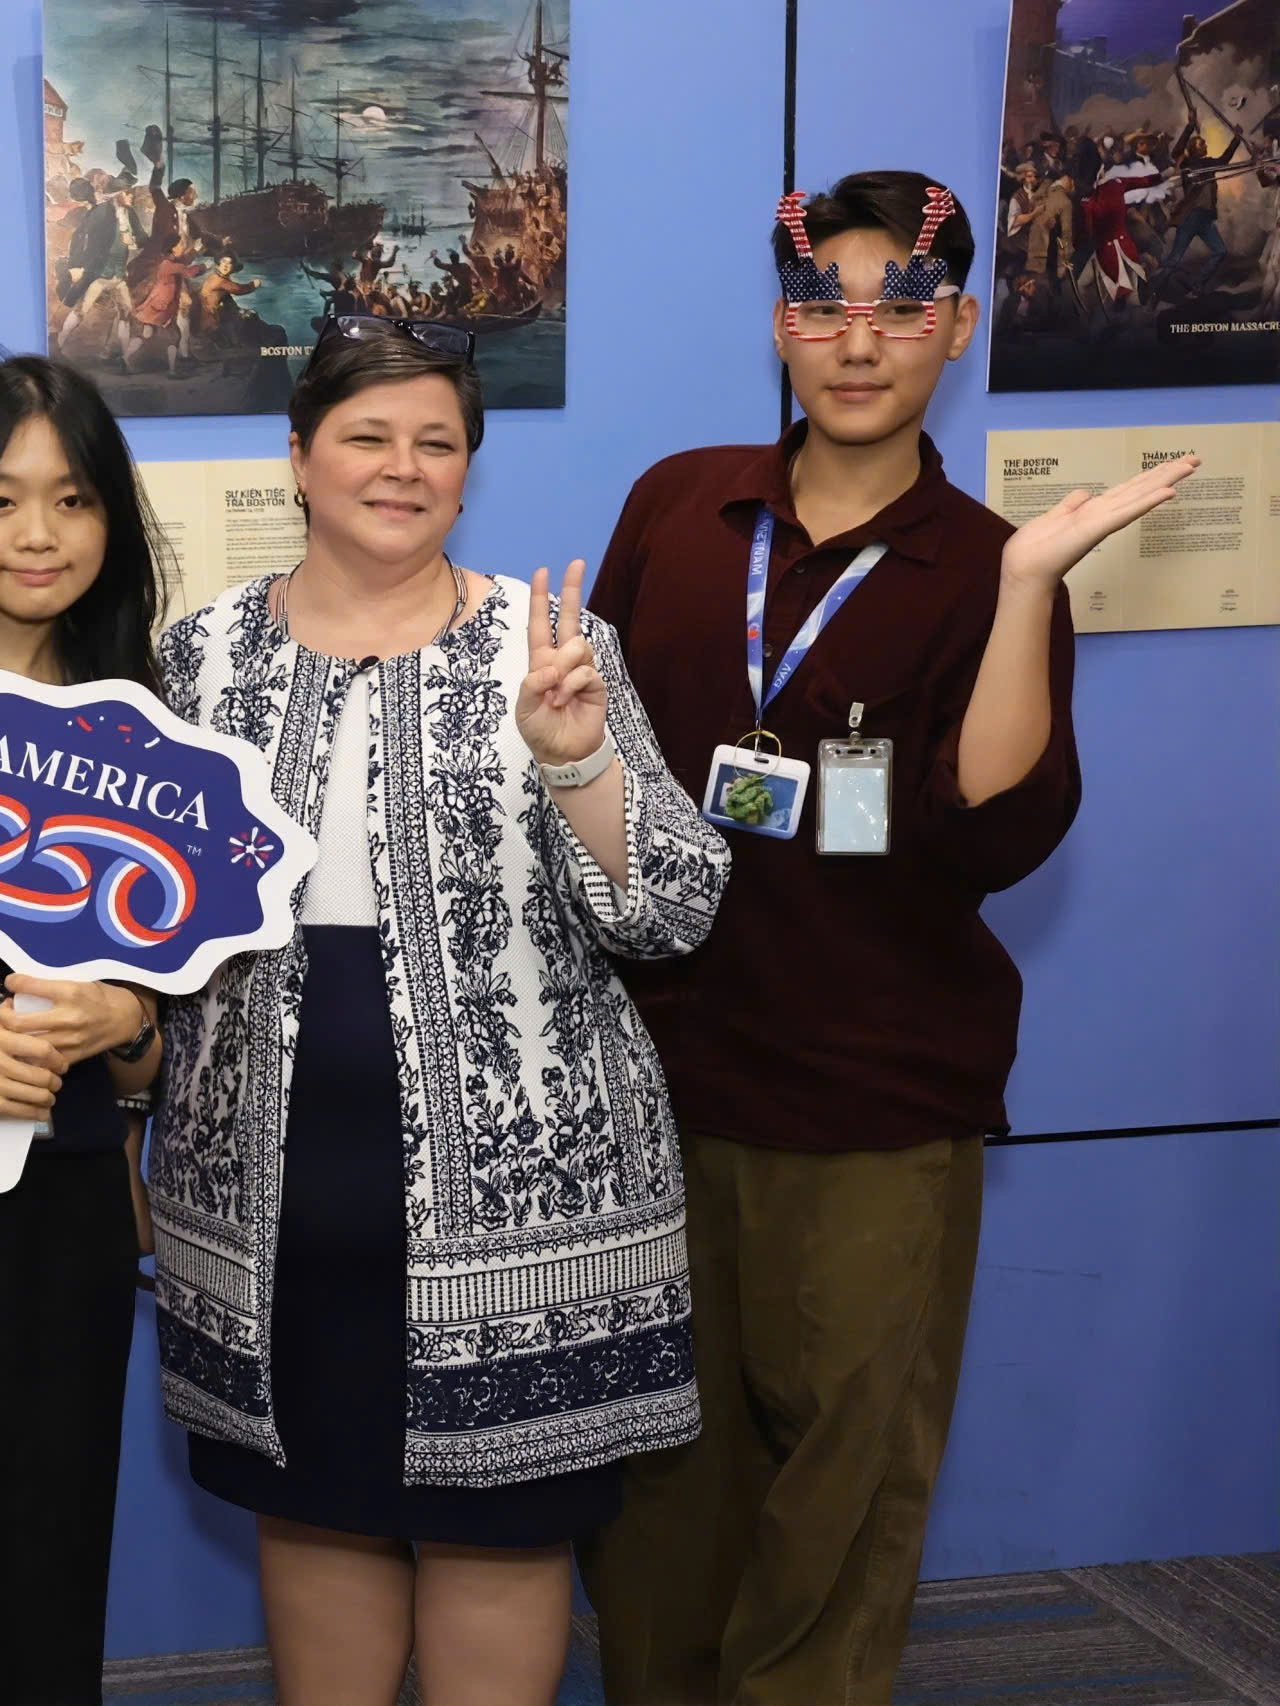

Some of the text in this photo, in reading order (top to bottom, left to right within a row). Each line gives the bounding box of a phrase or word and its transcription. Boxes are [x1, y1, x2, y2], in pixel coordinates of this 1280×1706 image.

[1170, 324, 1189, 333] THE
[1191, 323, 1228, 333] BOSTON
[260, 346, 302, 356] BOSTON
[1004, 458, 1059, 468] THE BOSTON
[1003, 467, 1051, 476] MASSACRE
[246, 498, 286, 507] BOSTON
[774, 663, 791, 688] DAV
[186, 844, 202, 857] TM
